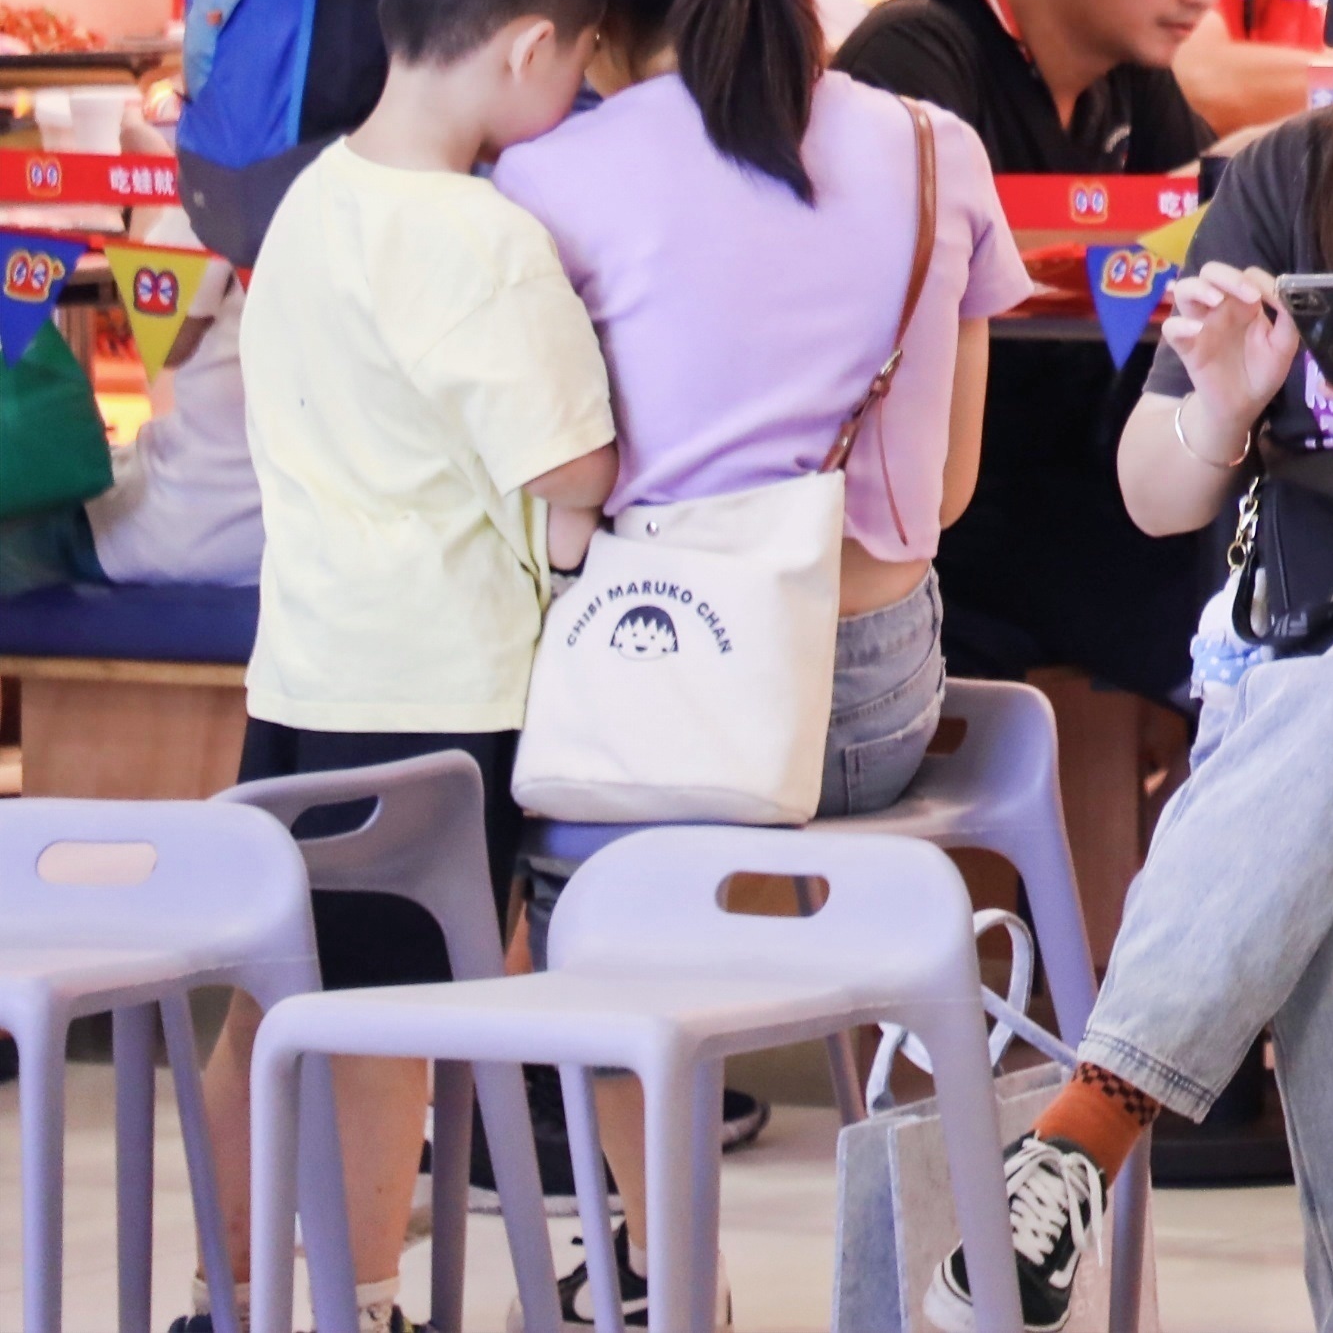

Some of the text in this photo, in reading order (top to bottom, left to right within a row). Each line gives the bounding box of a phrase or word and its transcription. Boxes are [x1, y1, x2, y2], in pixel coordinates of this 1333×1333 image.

[566, 580, 733, 655] CHIBI MARUKO CHAN
